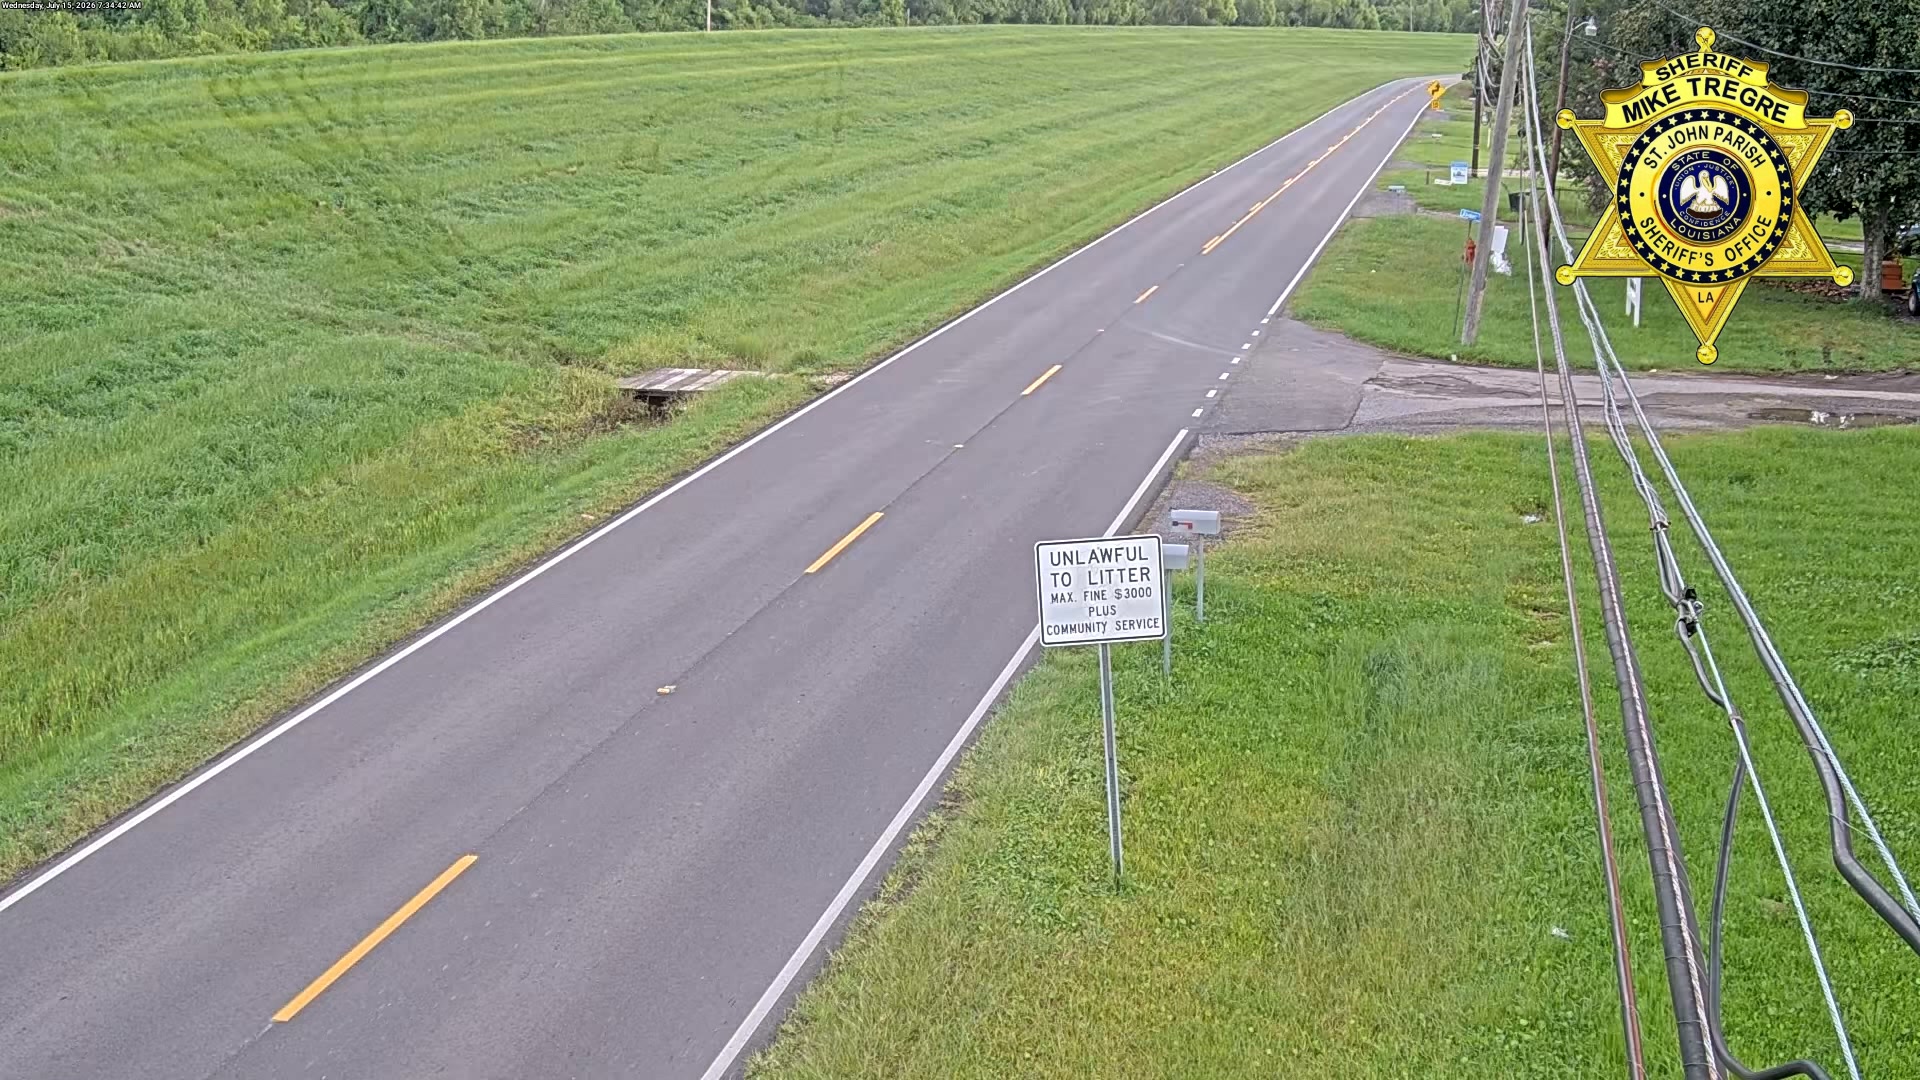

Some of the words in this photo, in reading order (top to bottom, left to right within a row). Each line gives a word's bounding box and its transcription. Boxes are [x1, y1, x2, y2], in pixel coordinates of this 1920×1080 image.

[1049, 546, 1149, 567] UNLAWFUL
[1050, 571, 1072, 588] TO
[1088, 567, 1151, 586] LITTER
[1050, 592, 1077, 604] MAX.
[1083, 590, 1108, 602] FINE
[1114, 586, 1152, 600] $3000
[1088, 605, 1117, 617] PLUS
[1046, 621, 1108, 636] COMMUNITY
[1115, 617, 1160, 631] SERVICE
